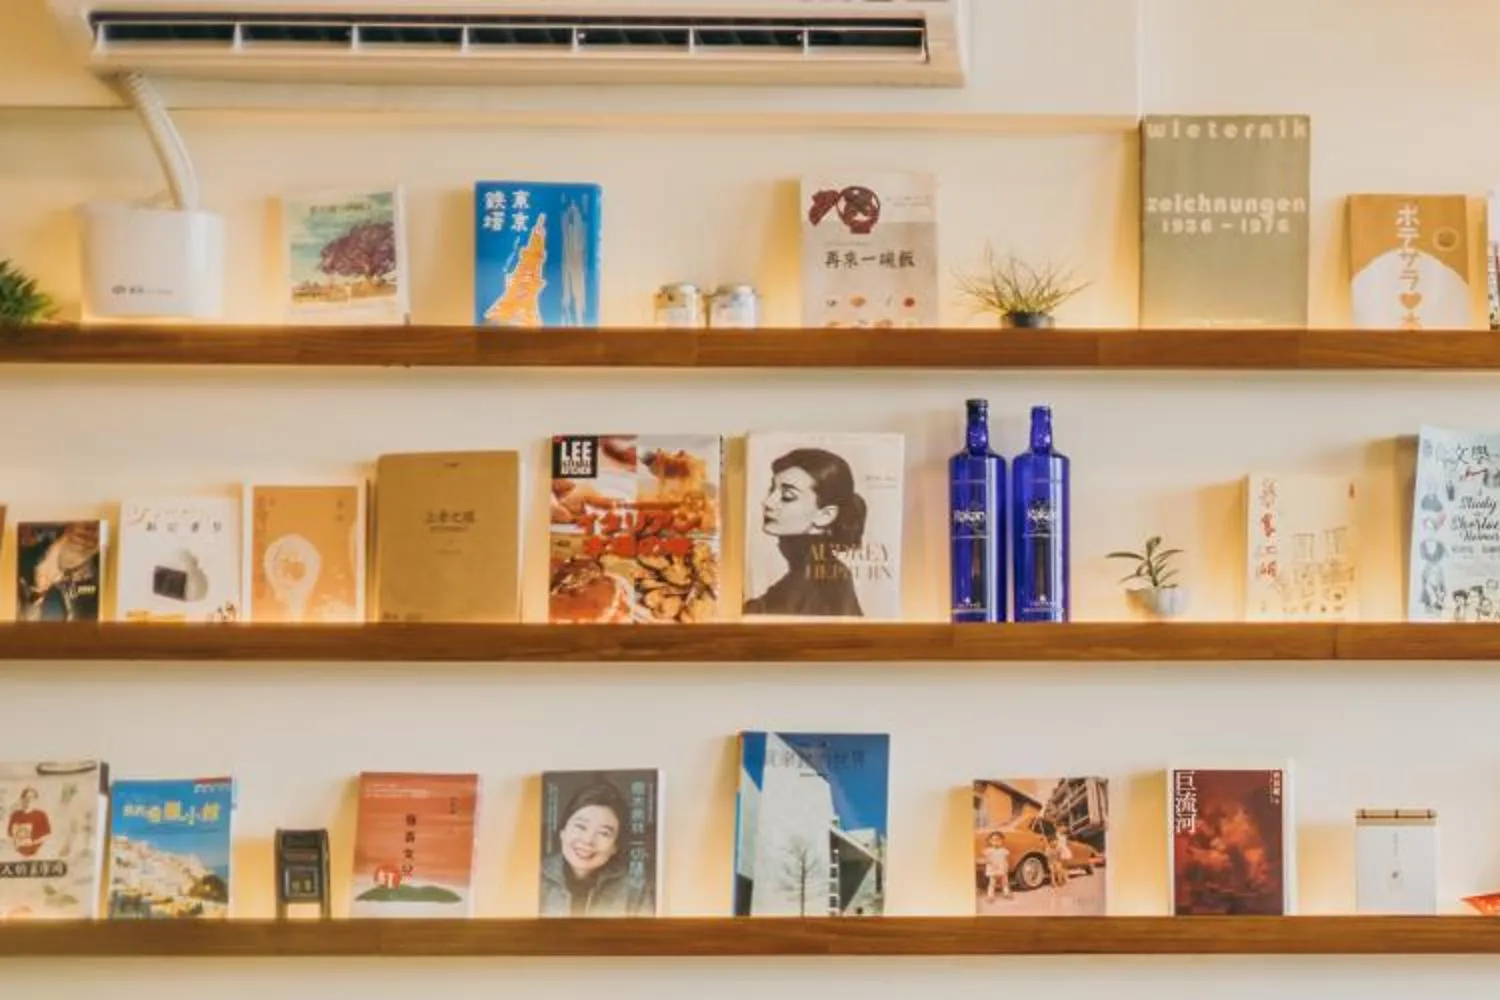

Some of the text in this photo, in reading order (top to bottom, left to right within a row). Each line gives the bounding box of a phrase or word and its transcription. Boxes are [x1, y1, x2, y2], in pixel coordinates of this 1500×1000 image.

[560, 441, 593, 460] LEE
[1175, 770, 1198, 834] 巨流河
